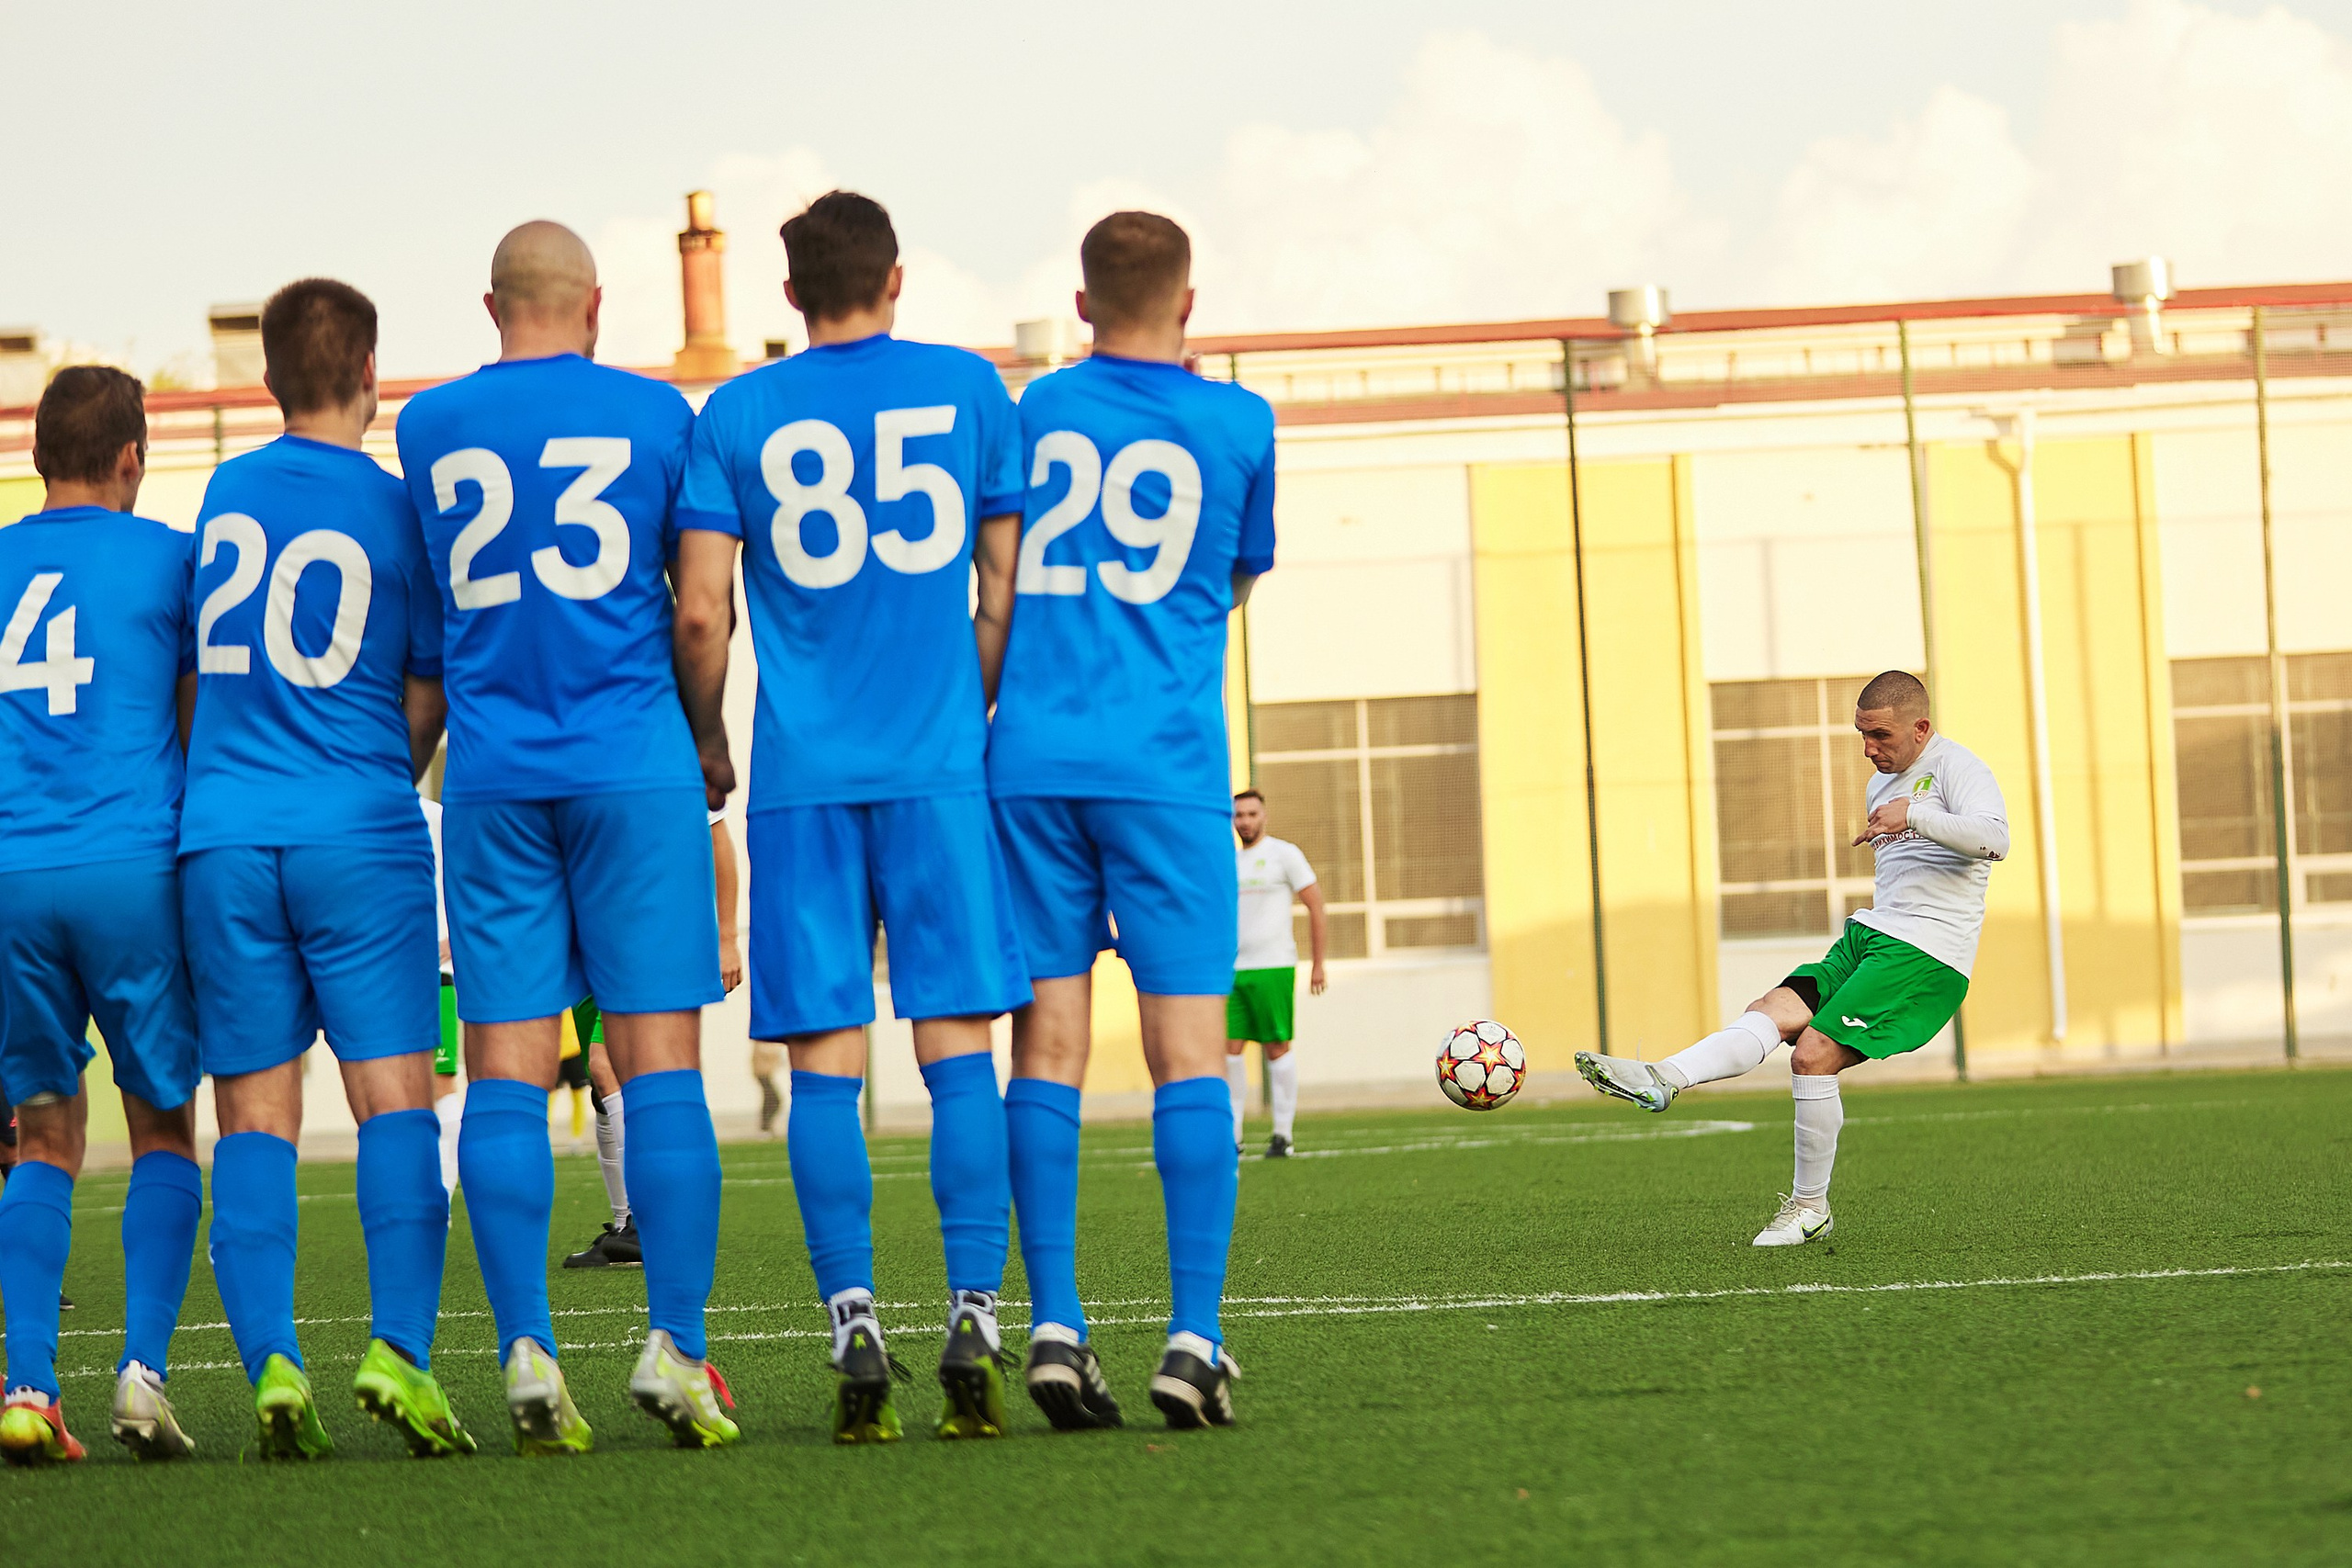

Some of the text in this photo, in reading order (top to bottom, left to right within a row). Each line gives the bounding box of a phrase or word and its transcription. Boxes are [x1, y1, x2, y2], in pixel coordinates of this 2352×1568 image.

[431, 437, 631, 610] 23
[762, 406, 966, 589] 85
[1015, 431, 1203, 604] 29
[0, 573, 95, 716] 4
[198, 513, 372, 689] 20
